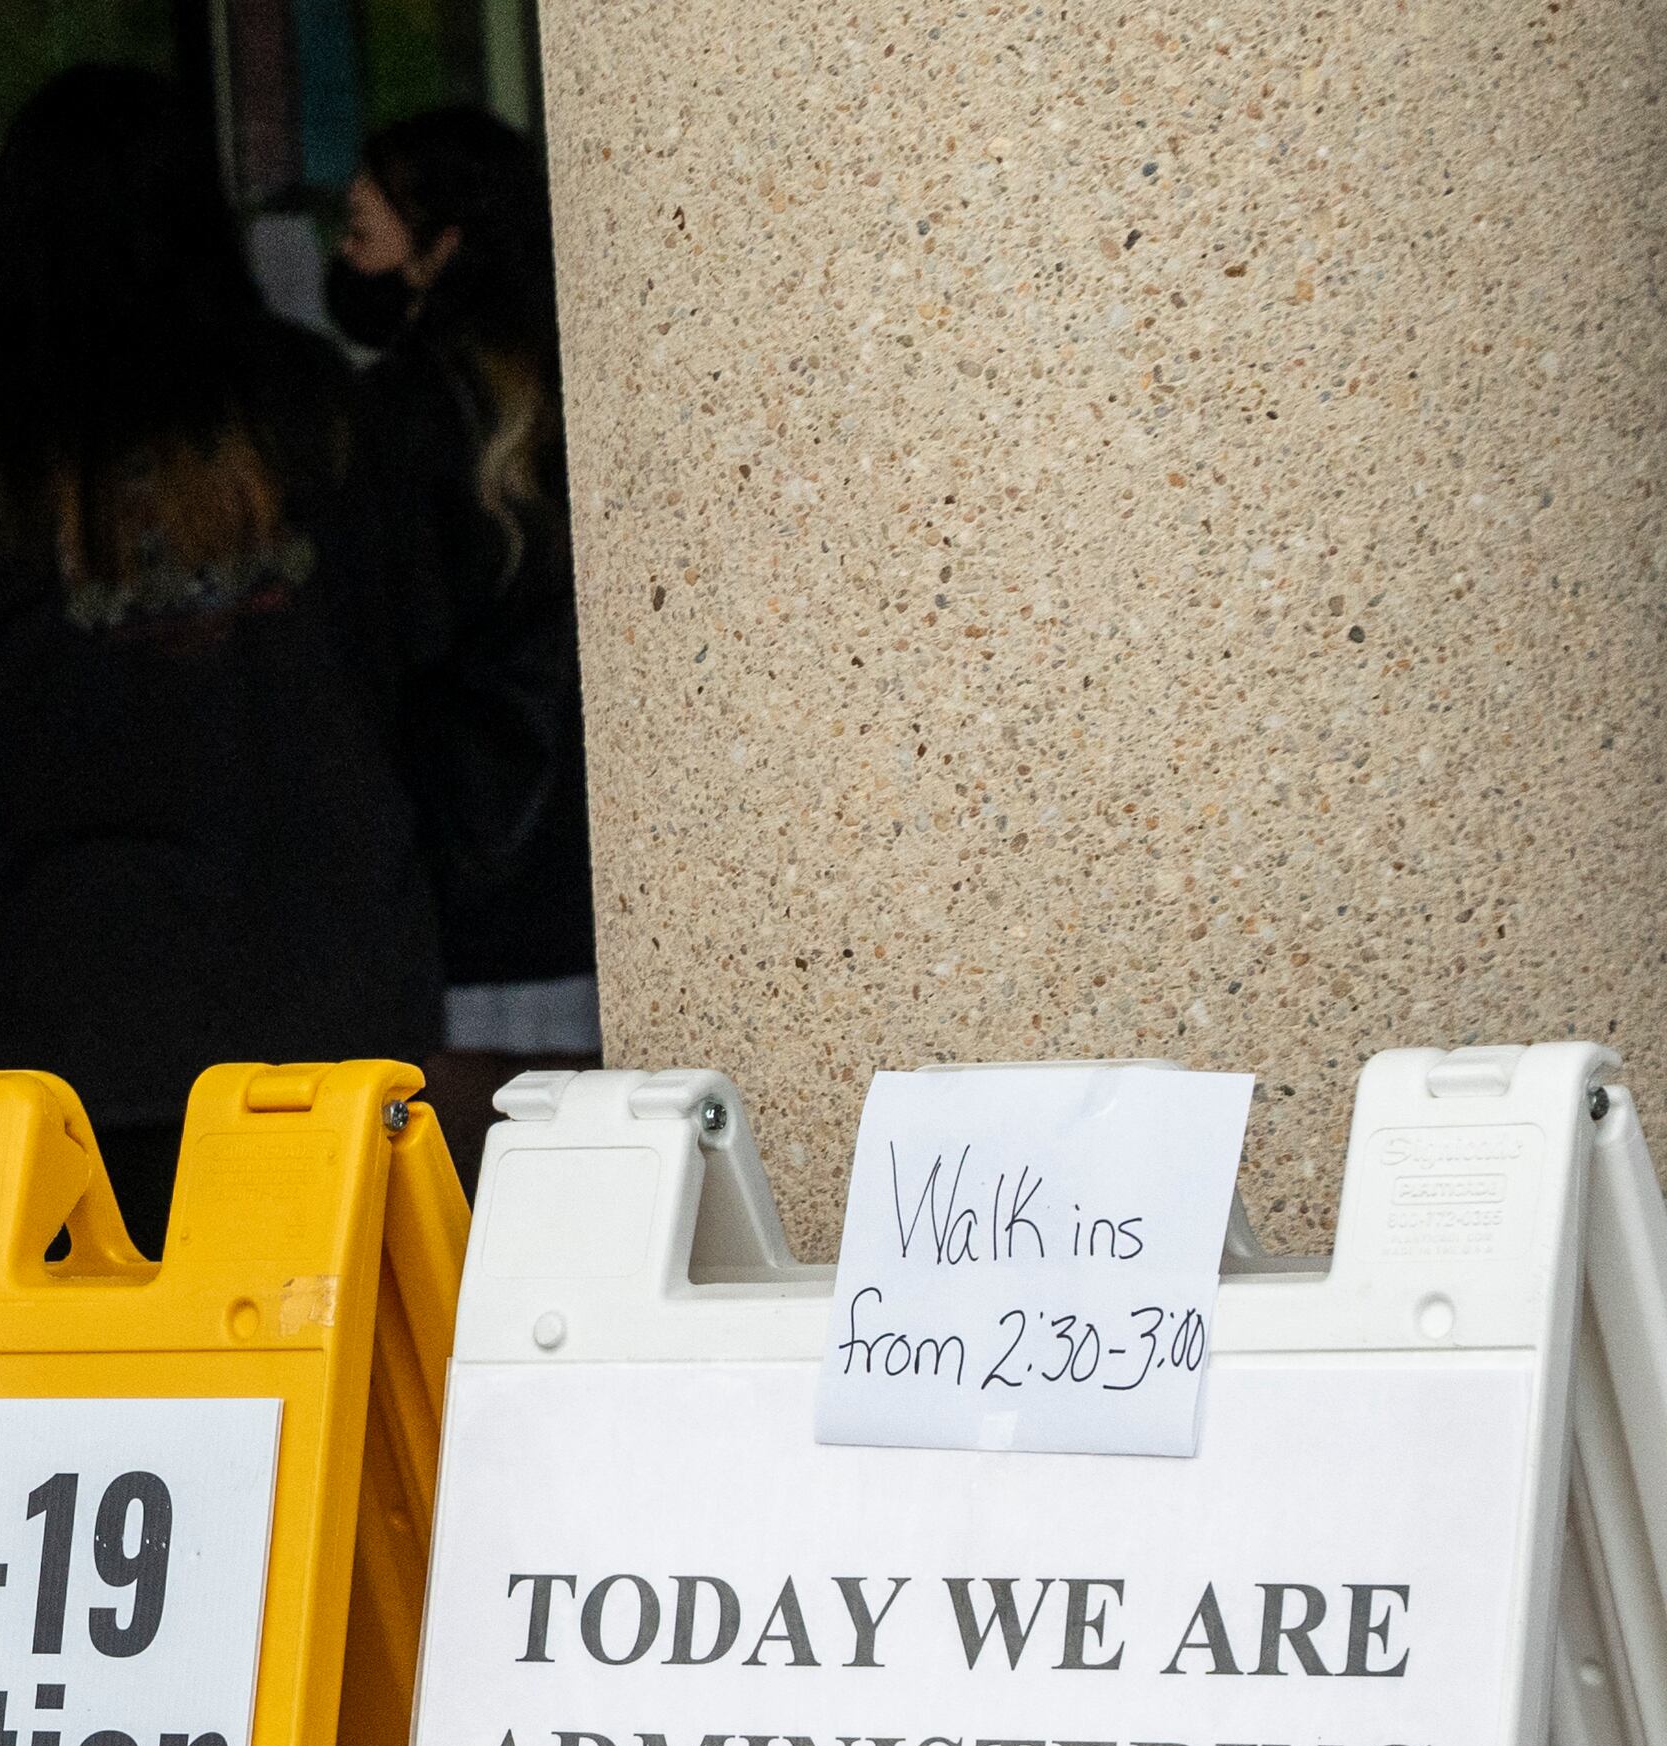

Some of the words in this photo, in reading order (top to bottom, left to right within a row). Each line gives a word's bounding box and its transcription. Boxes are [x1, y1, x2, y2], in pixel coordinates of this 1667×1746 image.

[1074, 1203, 1143, 1260] ins
[838, 1286, 965, 1386] from
[507, 1574, 910, 1669] TODAY
[942, 1578, 1125, 1671] WE
[1160, 1582, 1411, 1678] ARE
